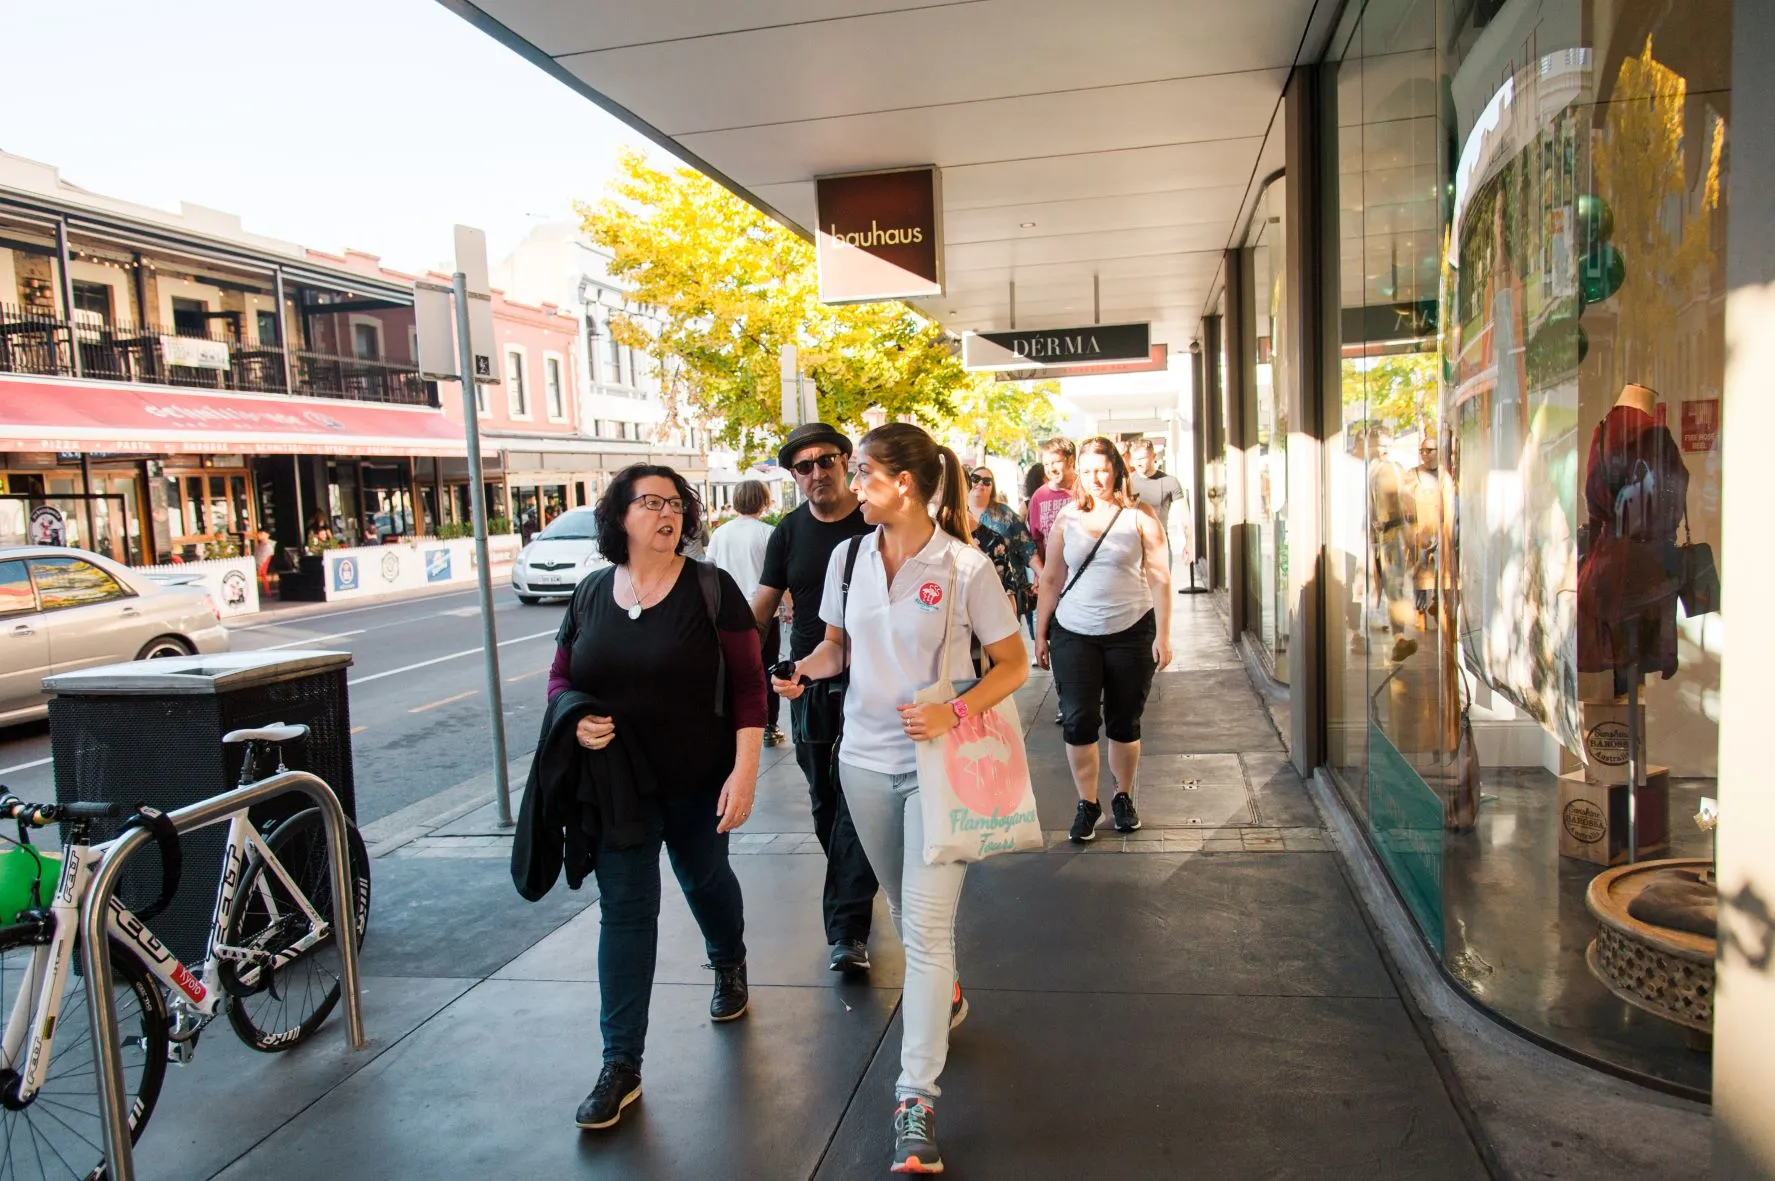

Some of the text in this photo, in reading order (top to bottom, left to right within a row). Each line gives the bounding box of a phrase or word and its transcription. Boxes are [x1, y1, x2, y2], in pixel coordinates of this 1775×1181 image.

[831, 220, 923, 248] bauhaus
[1012, 334, 1101, 359] DÉRMA
[41, 439, 80, 450] PIZZA
[116, 440, 153, 450] PASTA
[1591, 740, 1630, 748] BAROSS
[1565, 815, 1605, 830] BAROSSA
[978, 832, 1016, 857] Tours
[179, 968, 202, 995] Kyoto
